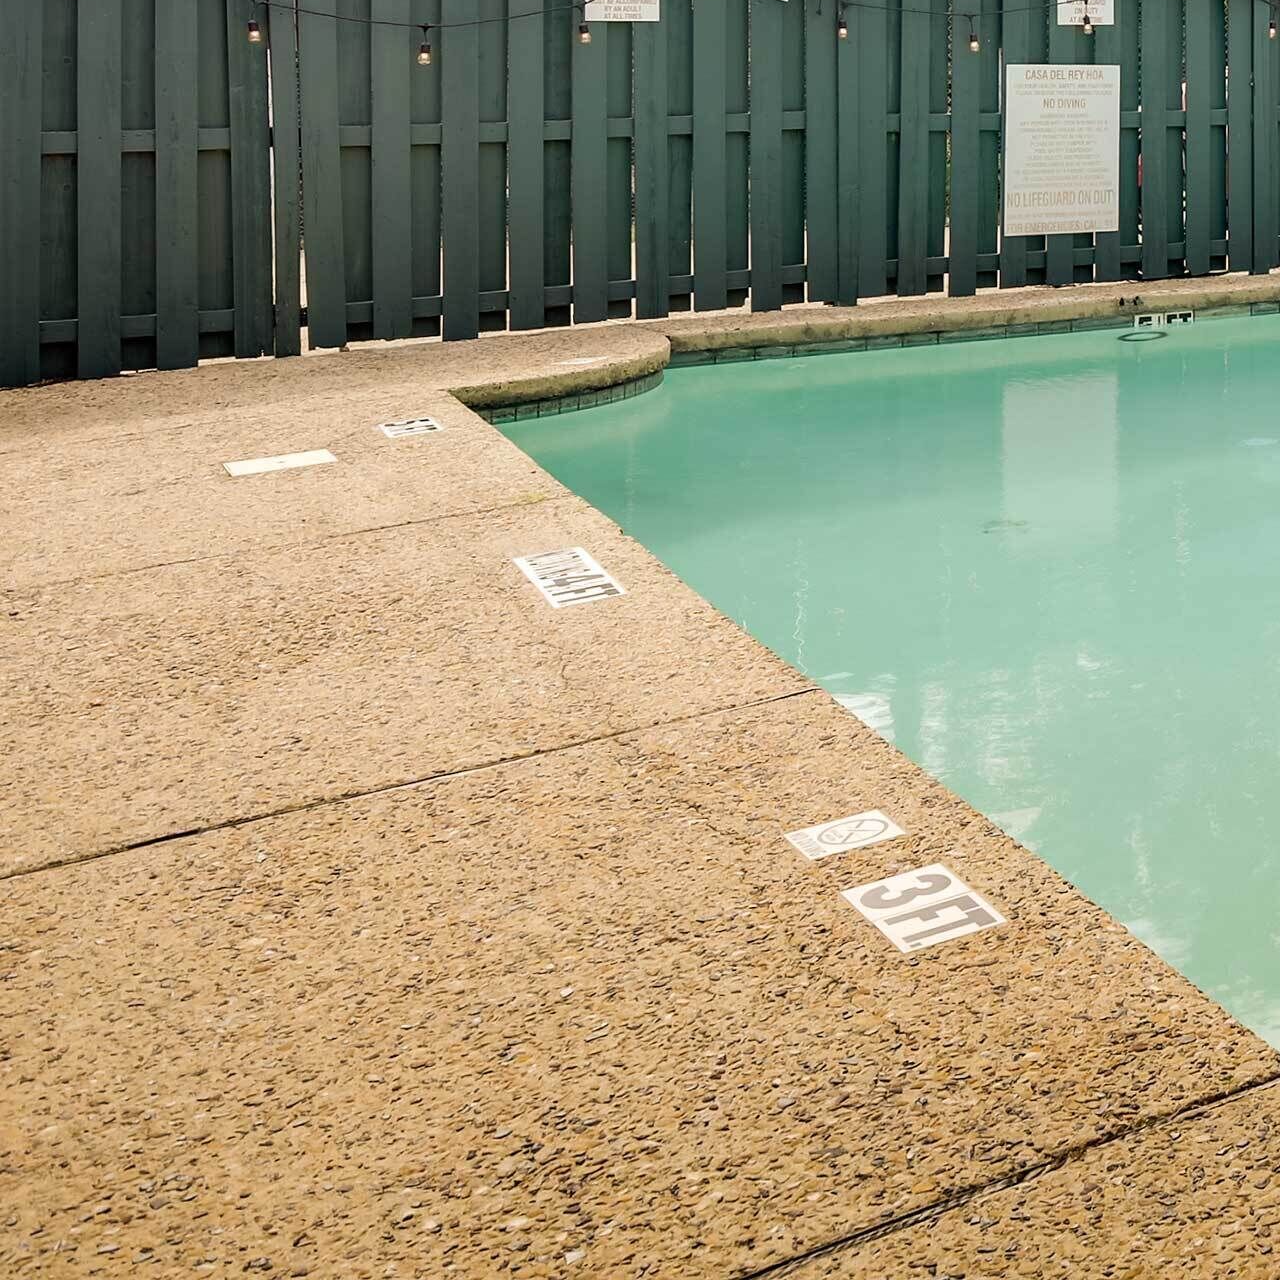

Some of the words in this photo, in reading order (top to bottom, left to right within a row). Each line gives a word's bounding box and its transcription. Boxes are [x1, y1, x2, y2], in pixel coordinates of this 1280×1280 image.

[1025, 70, 1048, 80] CASA
[1050, 70, 1066, 80] DEL
[1068, 70, 1086, 80] REY
[1086, 70, 1104, 80] HOA
[1043, 98, 1055, 109] NO
[1057, 98, 1086, 109] DIVING
[1007, 192, 1021, 208] NO
[1023, 191, 1076, 207] LIFEGUARD
[1078, 190, 1091, 204] ON
[859, 873, 952, 909] 3
